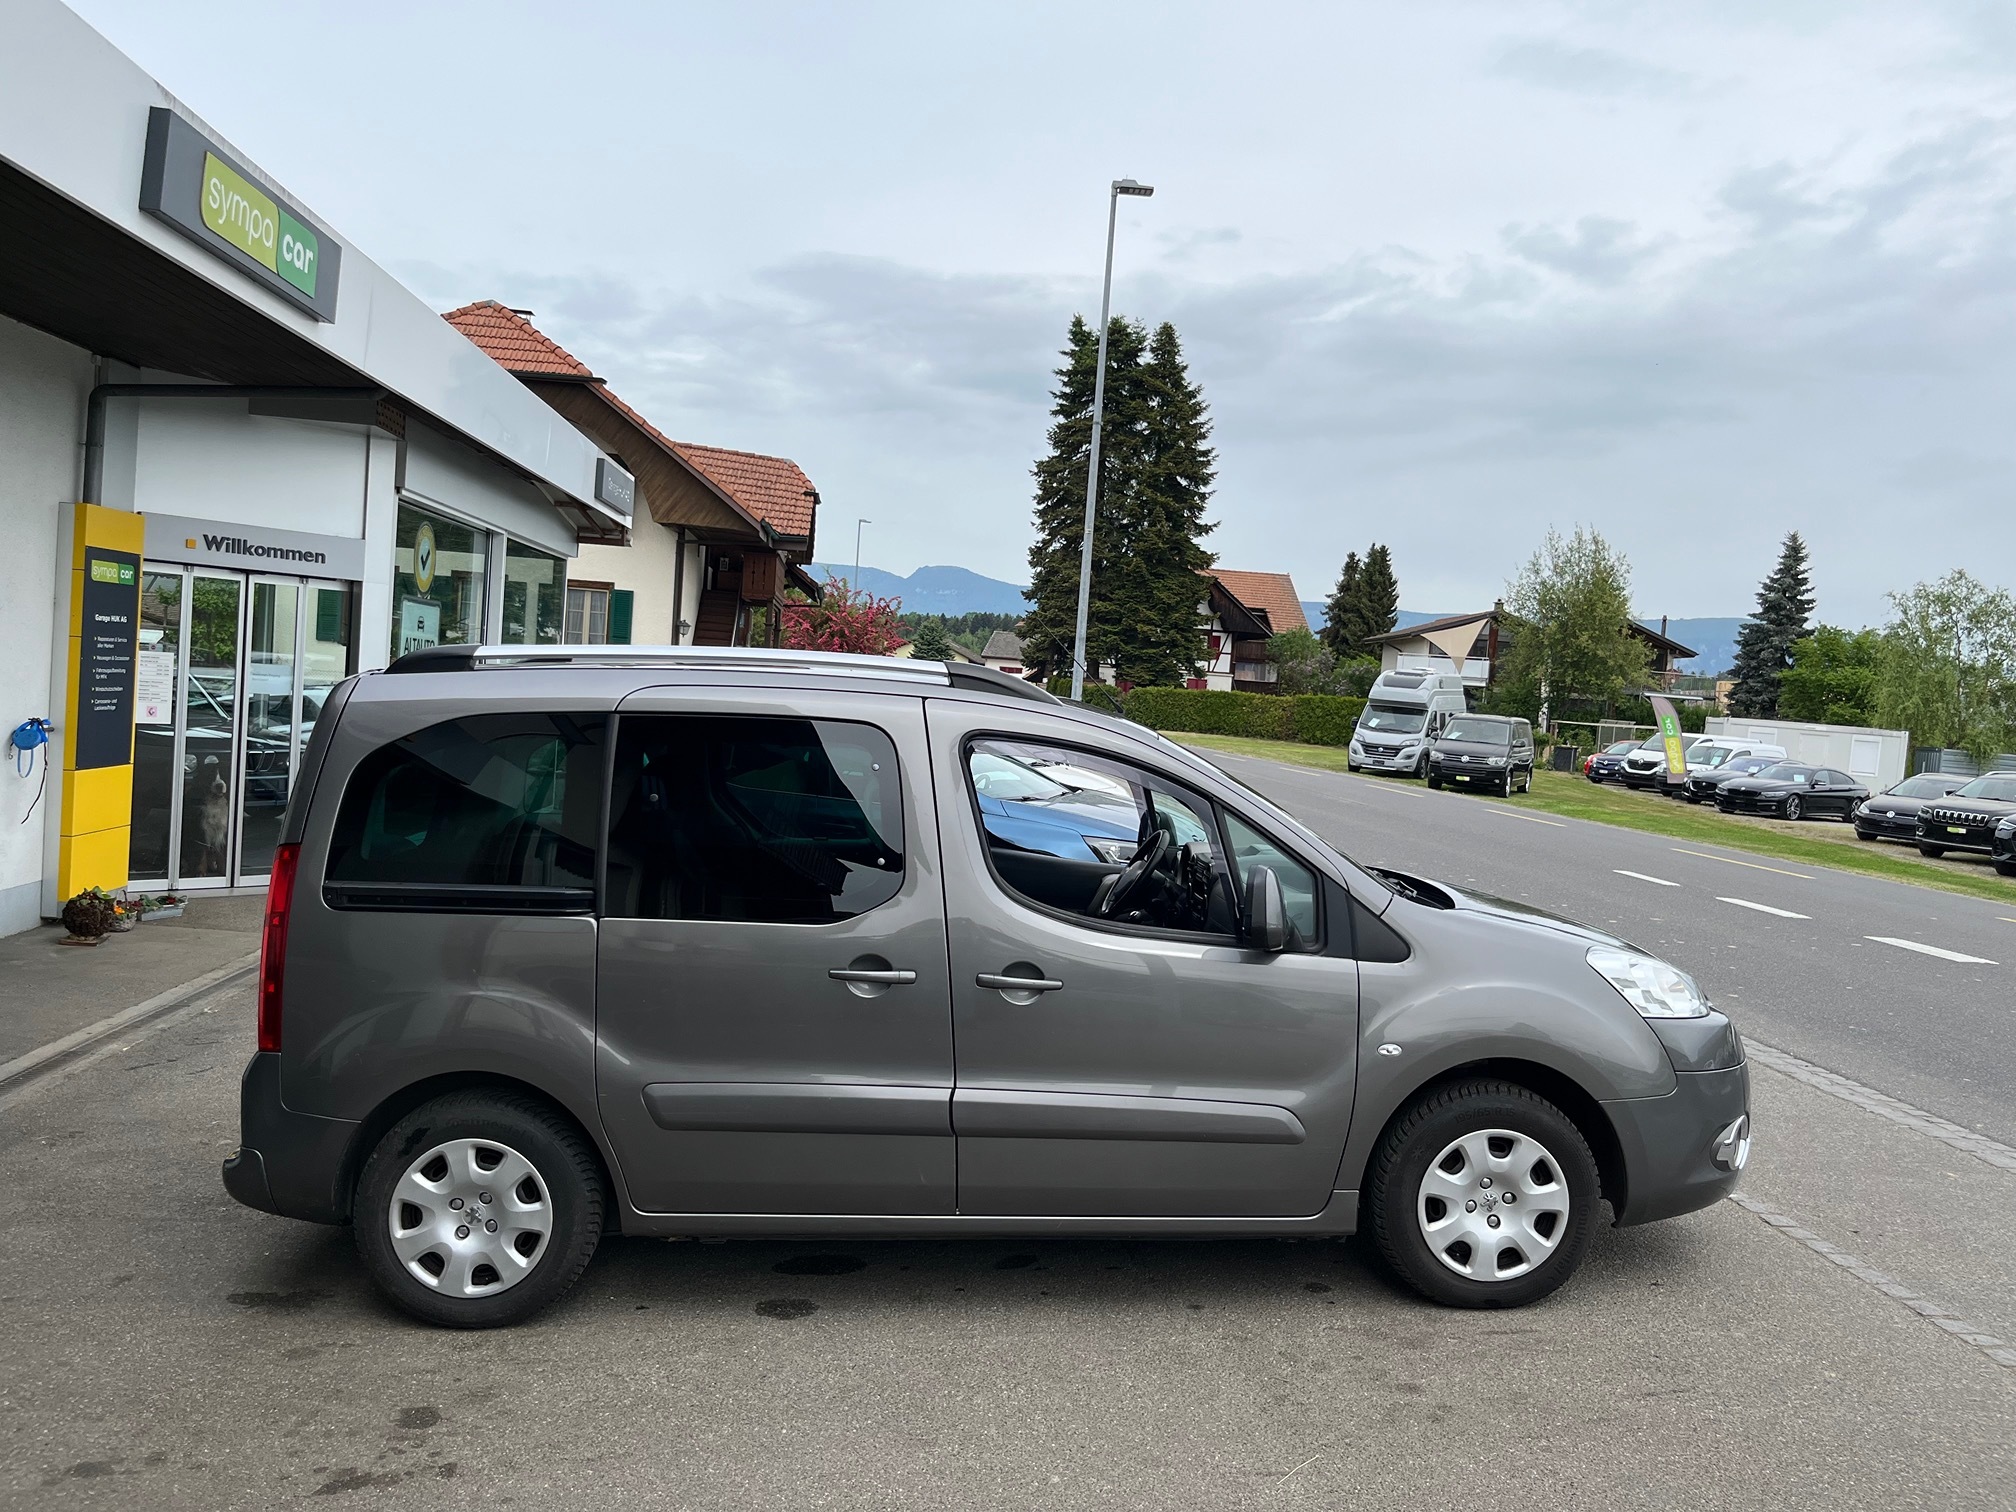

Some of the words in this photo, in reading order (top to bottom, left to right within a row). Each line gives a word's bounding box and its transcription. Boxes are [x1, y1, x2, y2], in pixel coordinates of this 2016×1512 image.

[209, 178, 274, 248] sympa
[282, 234, 314, 273] car
[203, 534, 326, 564] Willkommen
[93, 566, 118, 579] sympa
[120, 569, 133, 579] car
[95, 614, 111, 623] Garage
[1665, 718, 1674, 736] car
[1454, 1107, 1490, 1123] 195/65
[1554, 1205, 1591, 1274] Continental
